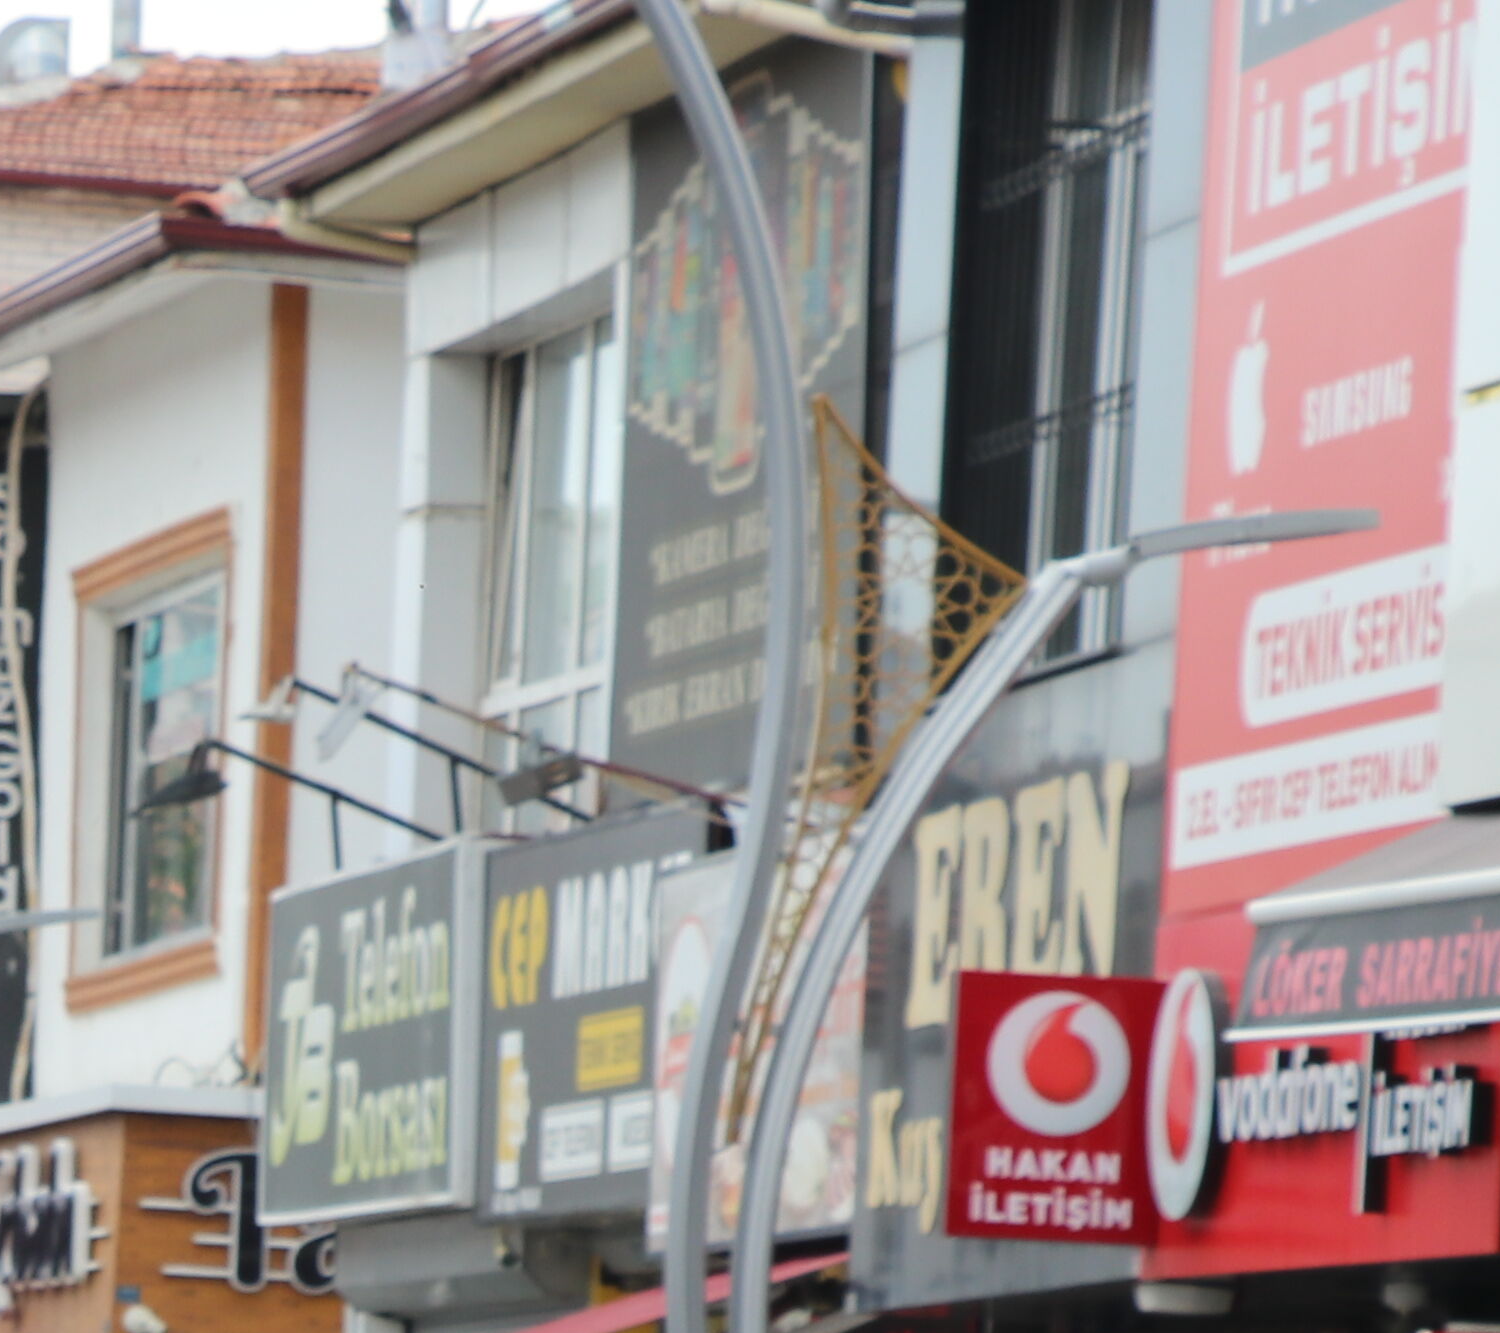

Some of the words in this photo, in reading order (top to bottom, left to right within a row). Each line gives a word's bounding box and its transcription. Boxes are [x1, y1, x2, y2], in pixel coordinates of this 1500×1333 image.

[1302, 355, 1413, 450] SAMSUNG
[1254, 589, 1352, 702] TEKNİK
[1351, 562, 1446, 677] SERVİS
[1316, 750, 1392, 811] TELEFON
[490, 884, 550, 1010] CEP
[552, 853, 692, 999] MARK
[904, 757, 1131, 1029] EREN
[340, 885, 451, 1033] Telefon
[1251, 939, 1349, 1017] LÖKER
[331, 1058, 447, 1186] Borsası
[1216, 1044, 1362, 1144] vodafone
[1370, 1064, 1474, 1158] İLETİŞİM
[969, 1182, 1134, 1232] İLETİŞİM
[984, 1144, 1122, 1185] HAKAN
